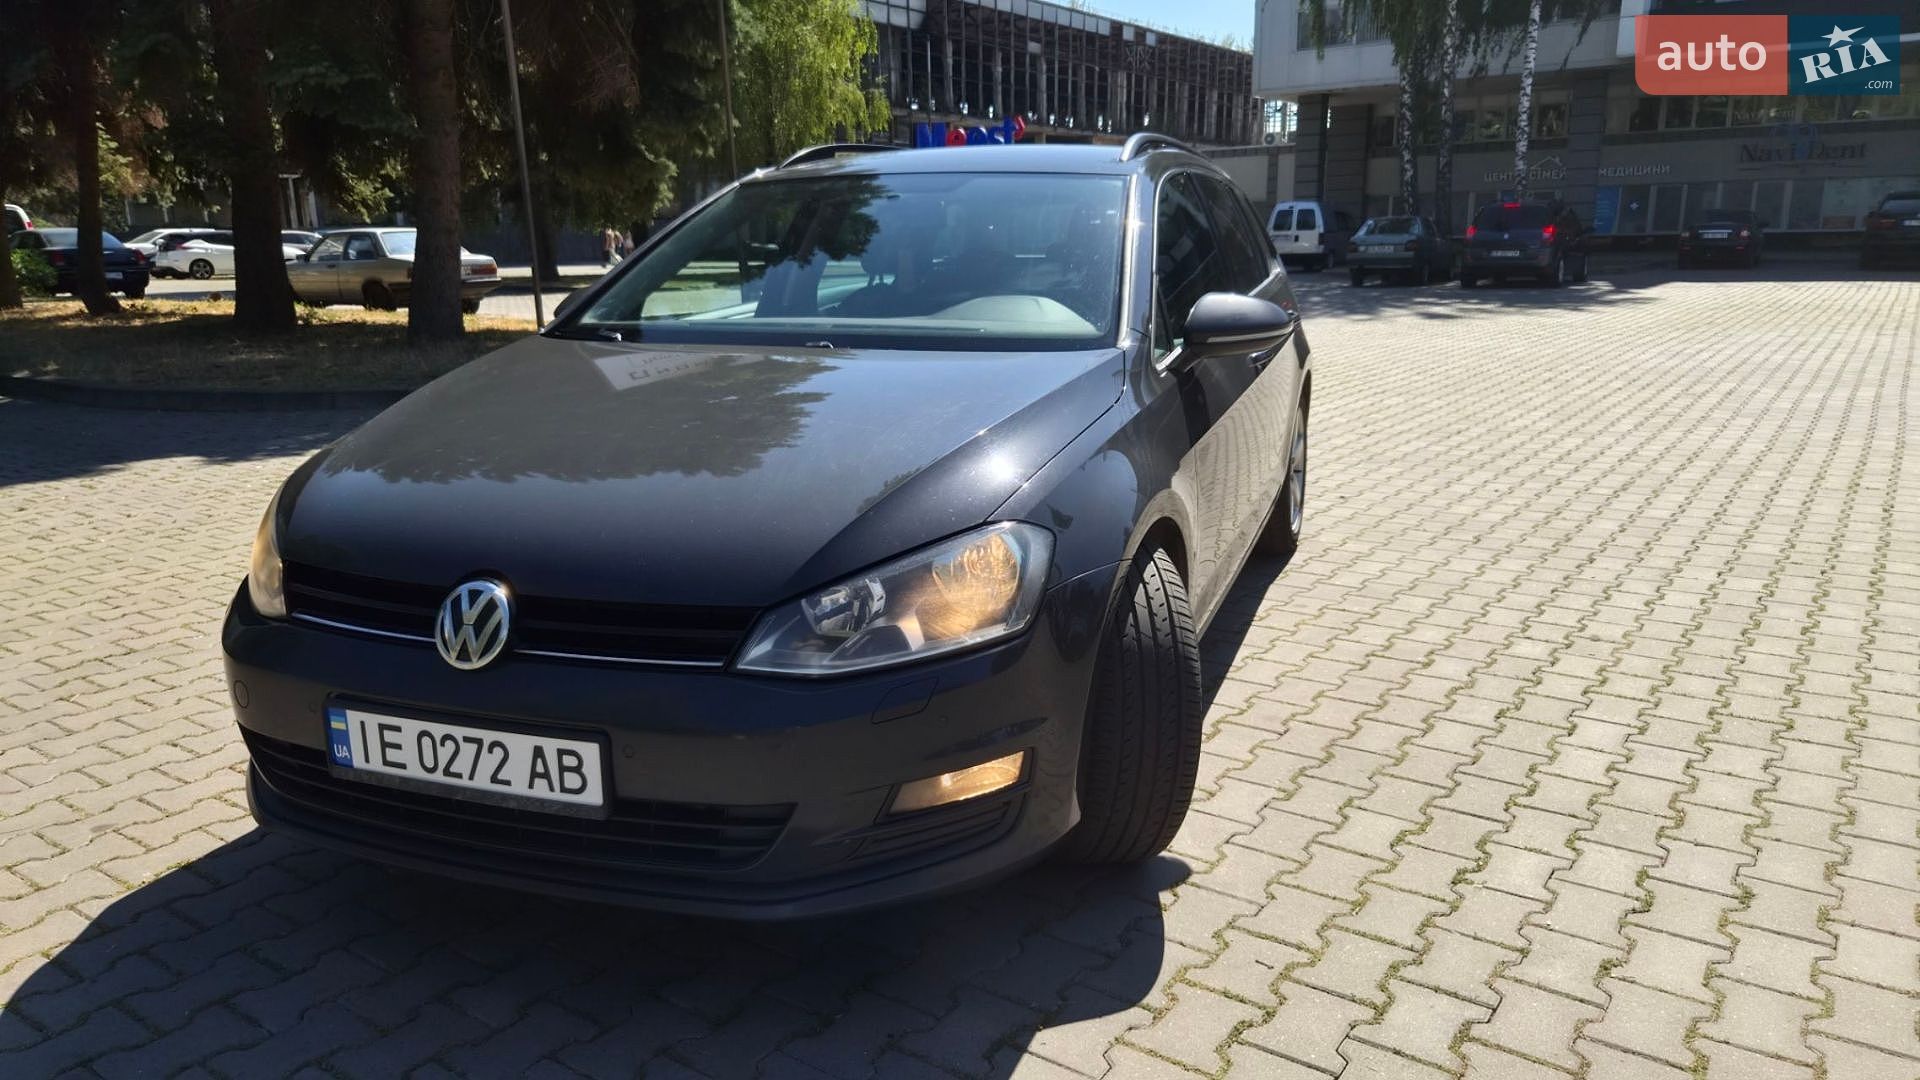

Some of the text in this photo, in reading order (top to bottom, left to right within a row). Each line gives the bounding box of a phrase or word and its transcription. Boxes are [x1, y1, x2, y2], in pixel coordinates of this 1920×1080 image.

[1807, 142, 1868, 160] Dent
[1483, 171, 1514, 183] ЦЕНТ
[1598, 163, 1671, 177] МЕДИЦИНИ
[334, 743, 350, 759] UA
[359, 720, 588, 795] IE 0272 AB
